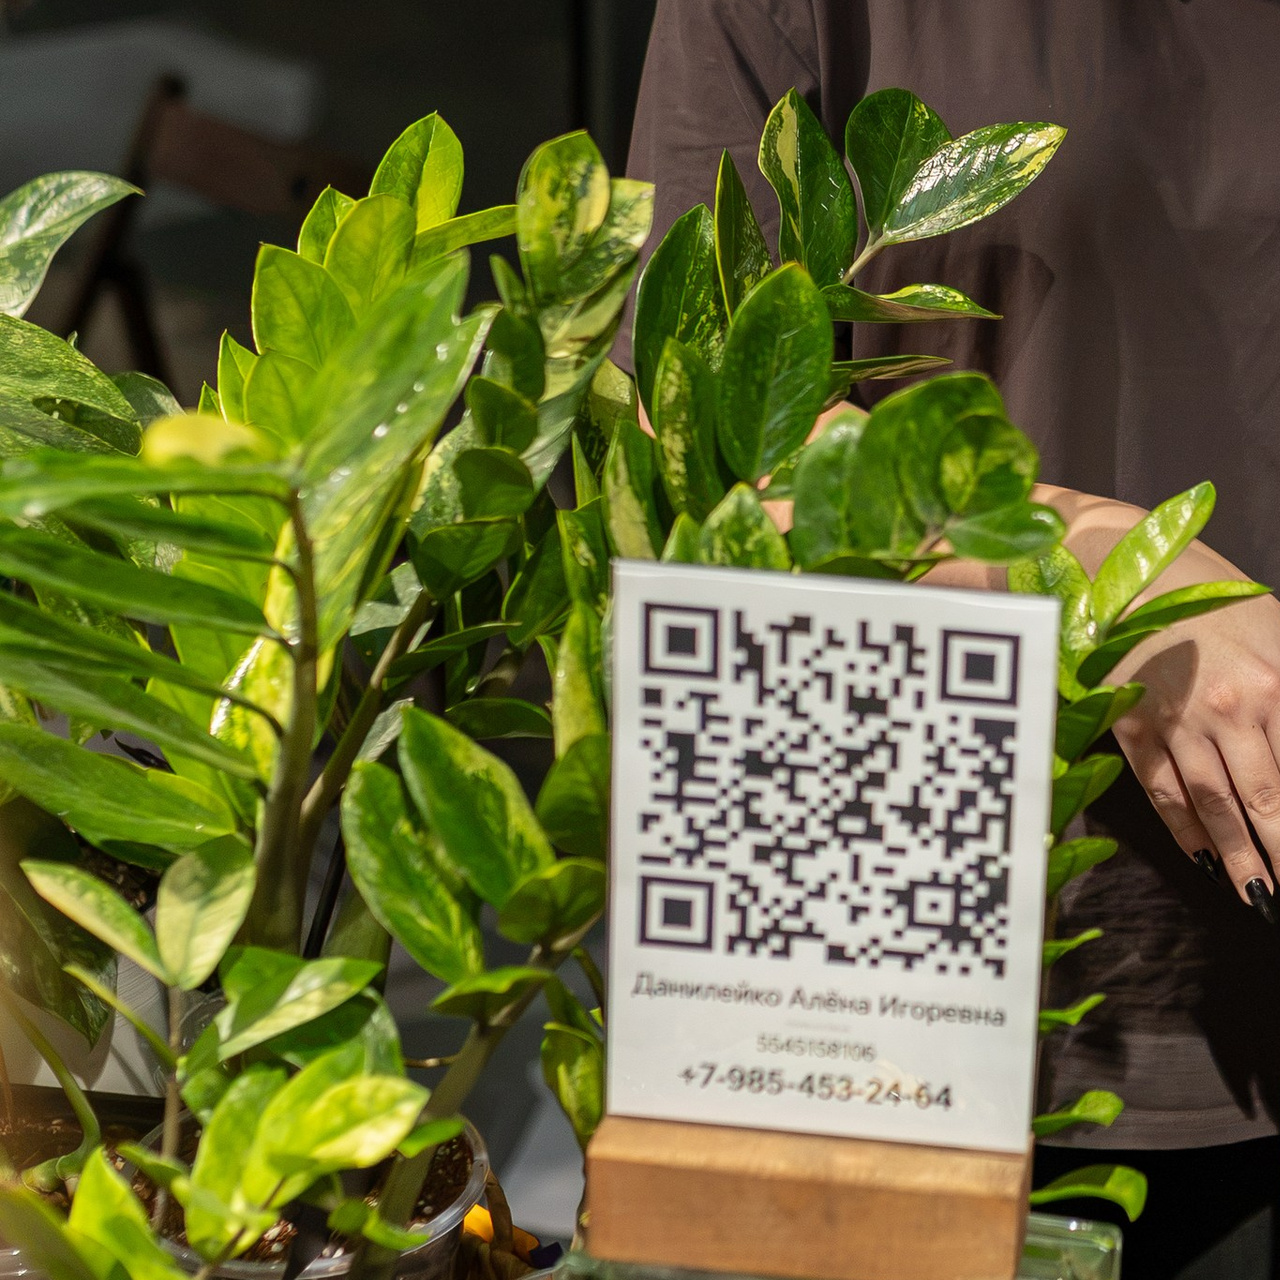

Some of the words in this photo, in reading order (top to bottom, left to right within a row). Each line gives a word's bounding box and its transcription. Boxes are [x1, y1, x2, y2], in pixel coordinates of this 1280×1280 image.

[630, 971, 783, 1008] Данилейко
[788, 983, 872, 1016] Алёна
[878, 994, 1007, 1027] Игоревна
[677, 1062, 953, 1111] +7-985-453-24-64
